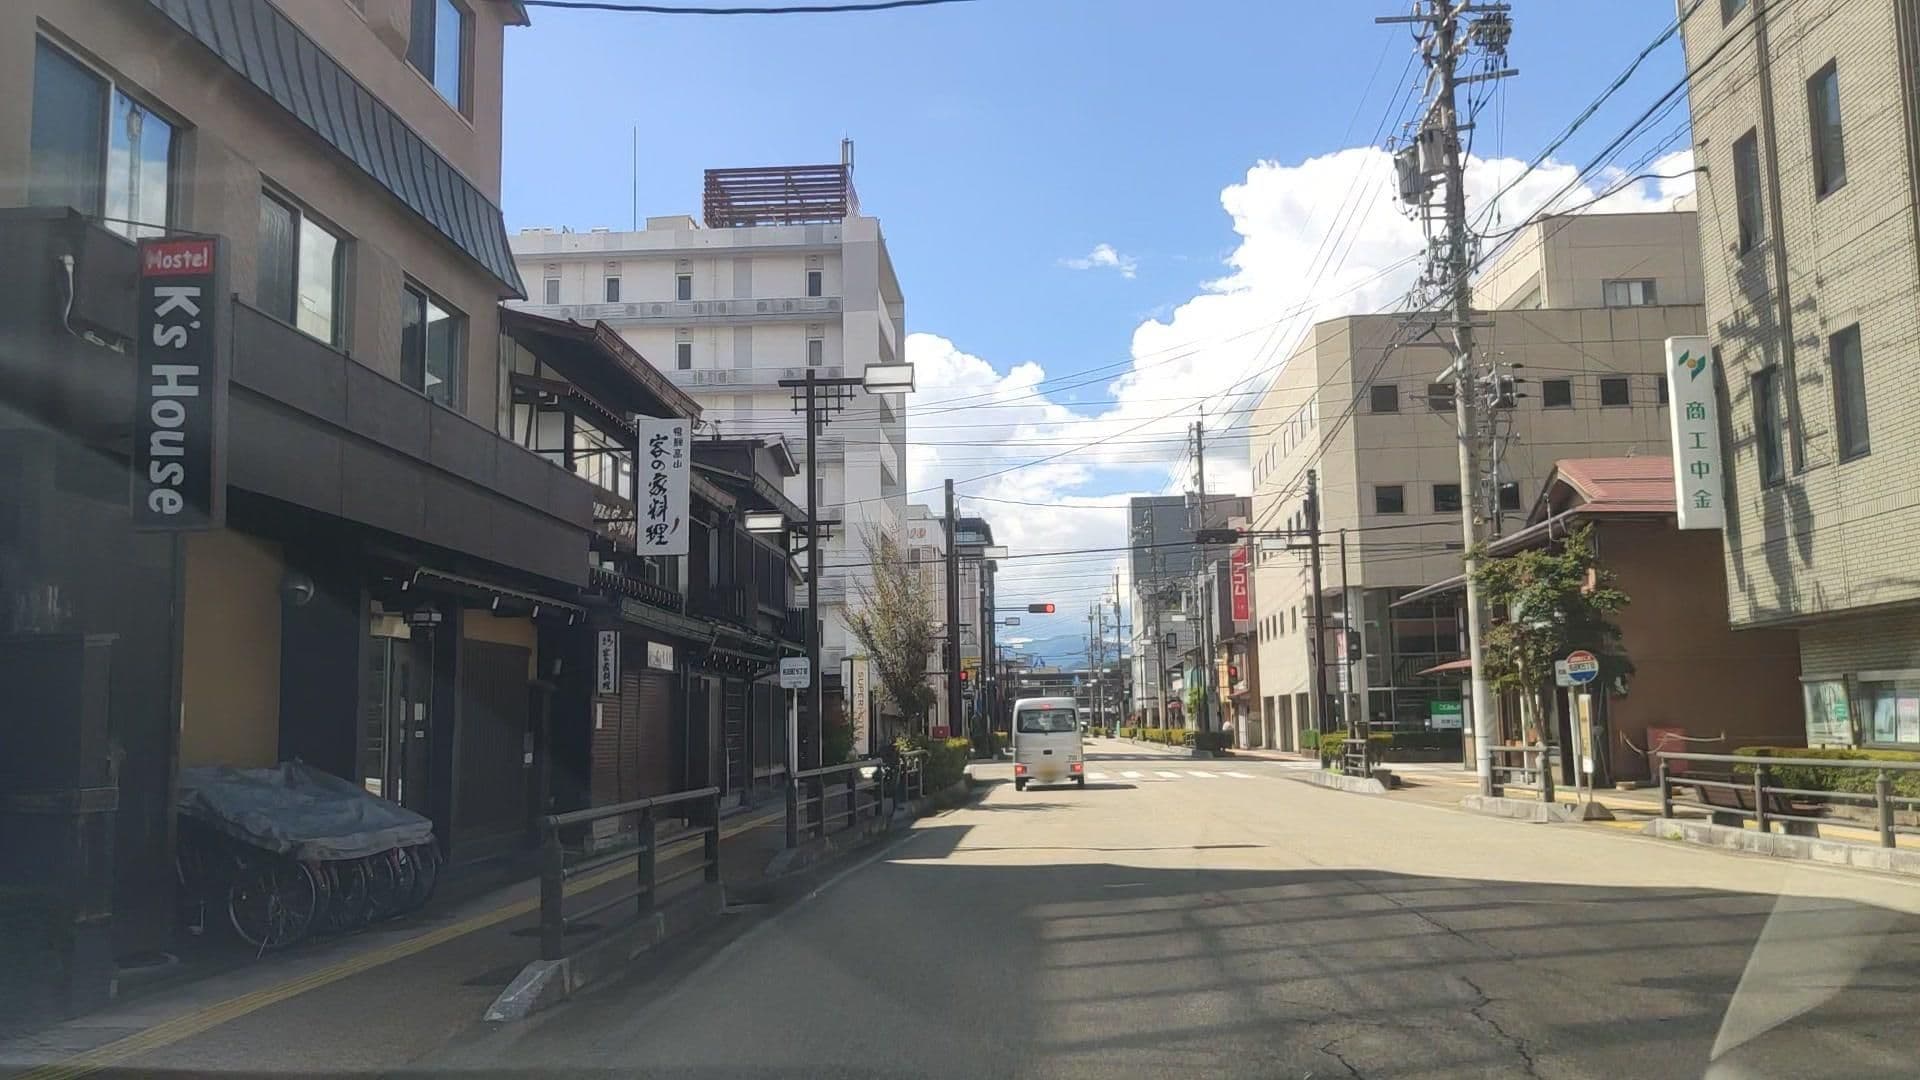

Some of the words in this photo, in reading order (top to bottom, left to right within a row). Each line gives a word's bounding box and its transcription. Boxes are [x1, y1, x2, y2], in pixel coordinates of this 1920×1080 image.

[147, 247, 209, 270] Hostel
[152, 286, 201, 349] K's
[149, 364, 200, 515] House
[1686, 401, 1712, 509] 商工中金
